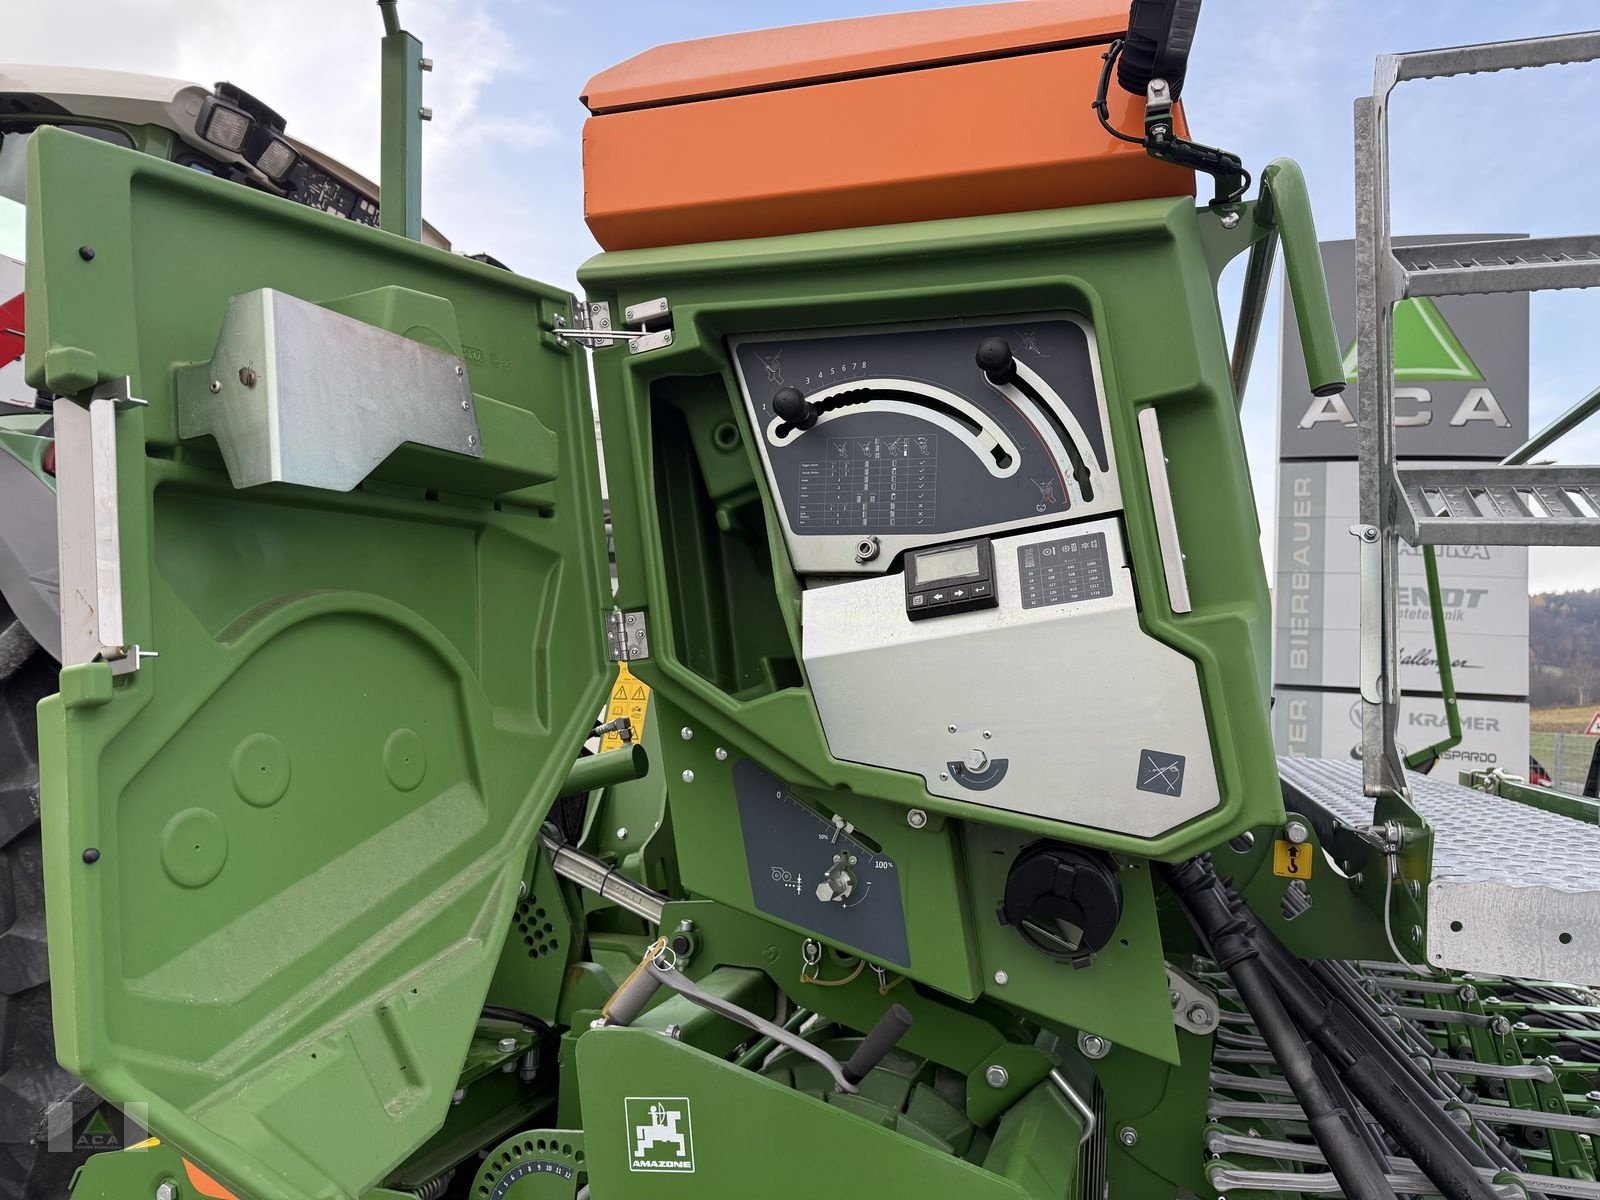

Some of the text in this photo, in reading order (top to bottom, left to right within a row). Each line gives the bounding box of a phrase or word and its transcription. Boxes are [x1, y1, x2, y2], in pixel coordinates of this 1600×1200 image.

[1297, 386, 1512, 429] ACA
[1289, 476, 1312, 670] BIERBAUER
[1398, 586, 1489, 609] ENDT
[1398, 608, 1465, 622] tetenik
[1399, 647, 1485, 674] allener
[1288, 699, 1307, 760] TER
[1439, 750, 1497, 764] SPARDO
[632, 1160, 692, 1168] AMAZONE
